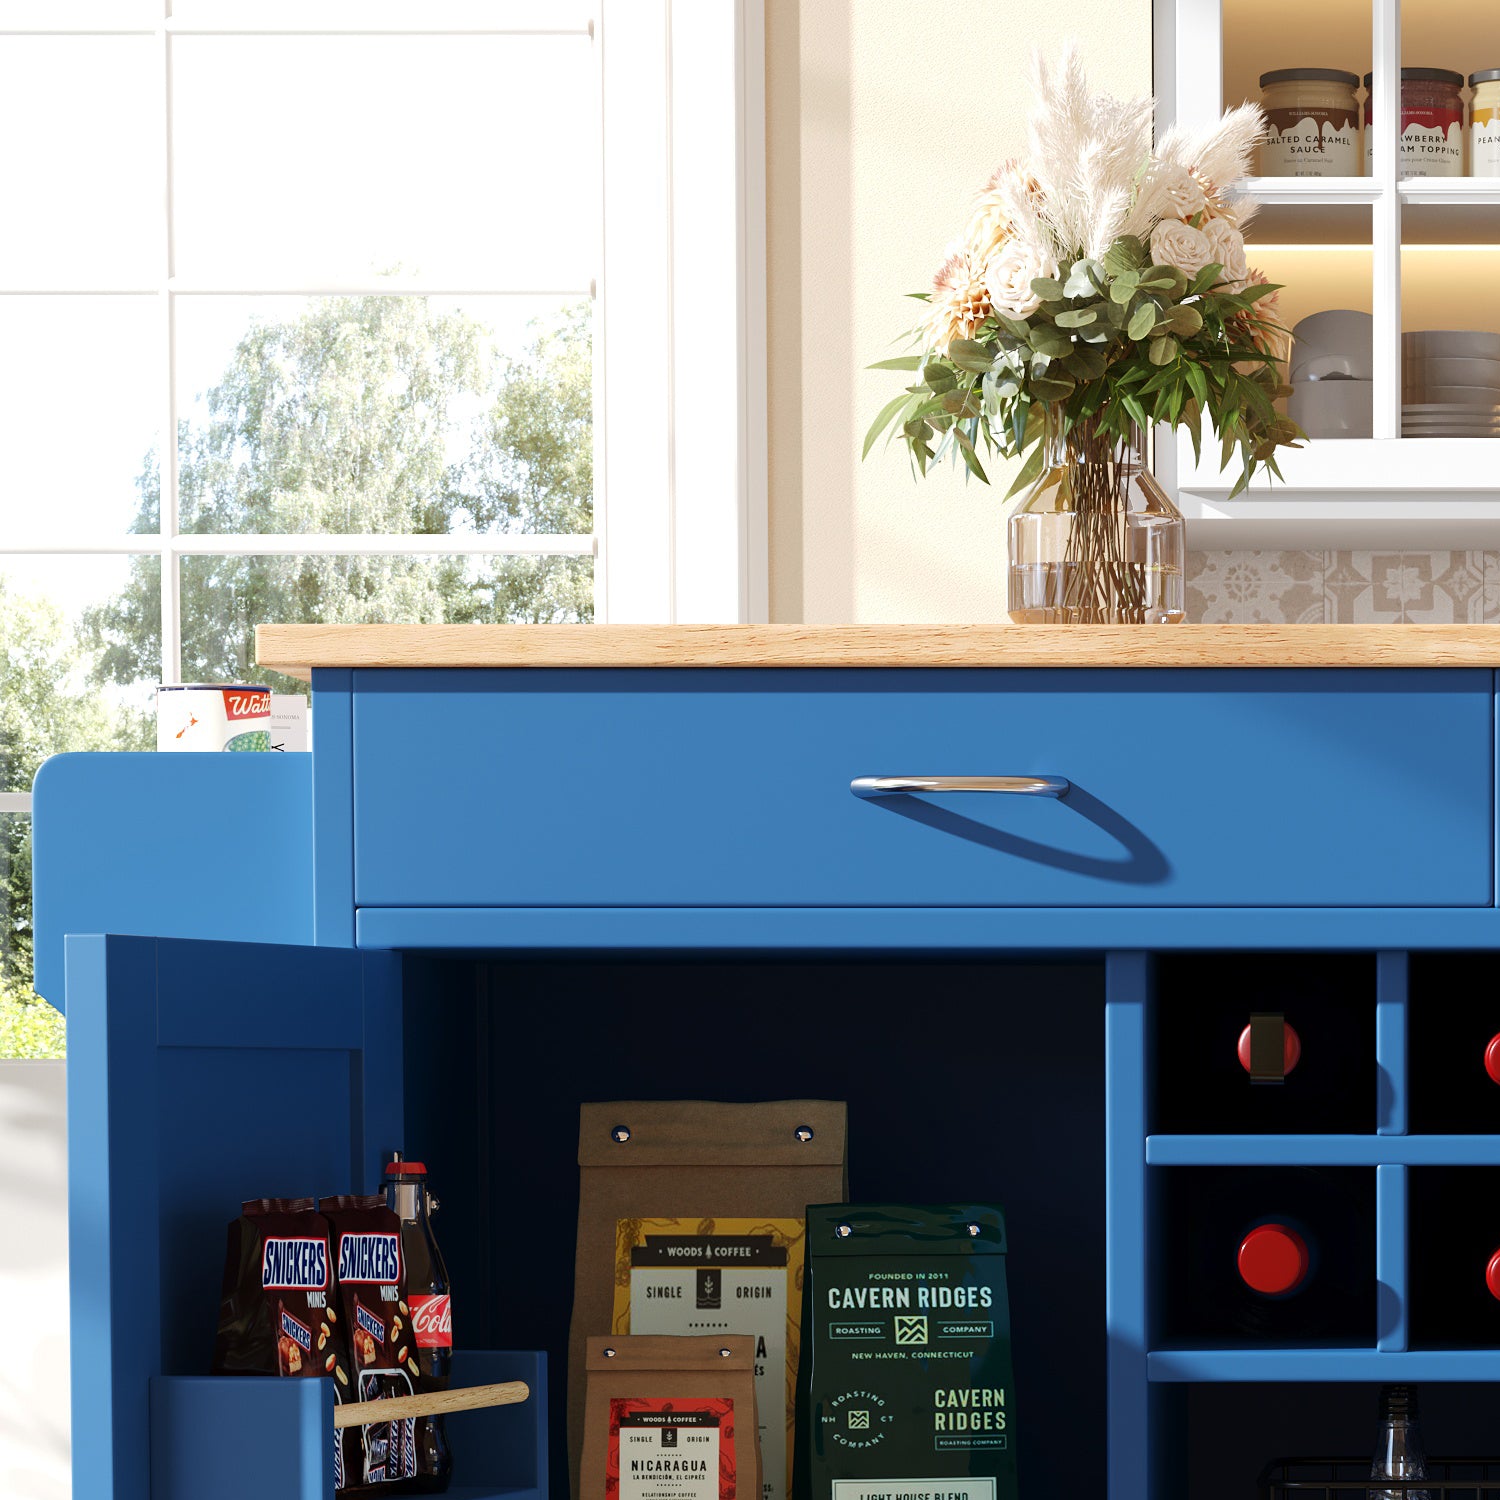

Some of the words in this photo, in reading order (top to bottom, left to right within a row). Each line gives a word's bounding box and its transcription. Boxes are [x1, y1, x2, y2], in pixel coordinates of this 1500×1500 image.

[1266, 136, 1300, 146] SALTED
[1305, 136, 1351, 146] CARAMEL
[1420, 146, 1460, 156] TOPPING
[339, 1236, 398, 1280] SNICKERS
[667, 1246, 703, 1257] WOODS
[714, 1246, 752, 1257] COFFEE
[263, 1240, 327, 1286] SNICKERS
[306, 1292, 327, 1308] MINIS
[646, 1286, 683, 1299] SINGLE
[736, 1286, 772, 1299] ORIGIN
[828, 1287, 909, 1309] CAVERN
[918, 1286, 992, 1308] RIDGES
[282, 1313, 311, 1350] SNICKERS
[358, 1306, 385, 1342] SNICKERS
[875, 1352, 908, 1360] HAVEN,
[832, 1391, 885, 1407] ROASTING
[934, 1388, 1005, 1408] CAVERN
[934, 1411, 1006, 1431] RIDGES
[833, 1433, 885, 1448] COMPANY
[631, 1460, 707, 1471] NICARAGUA
